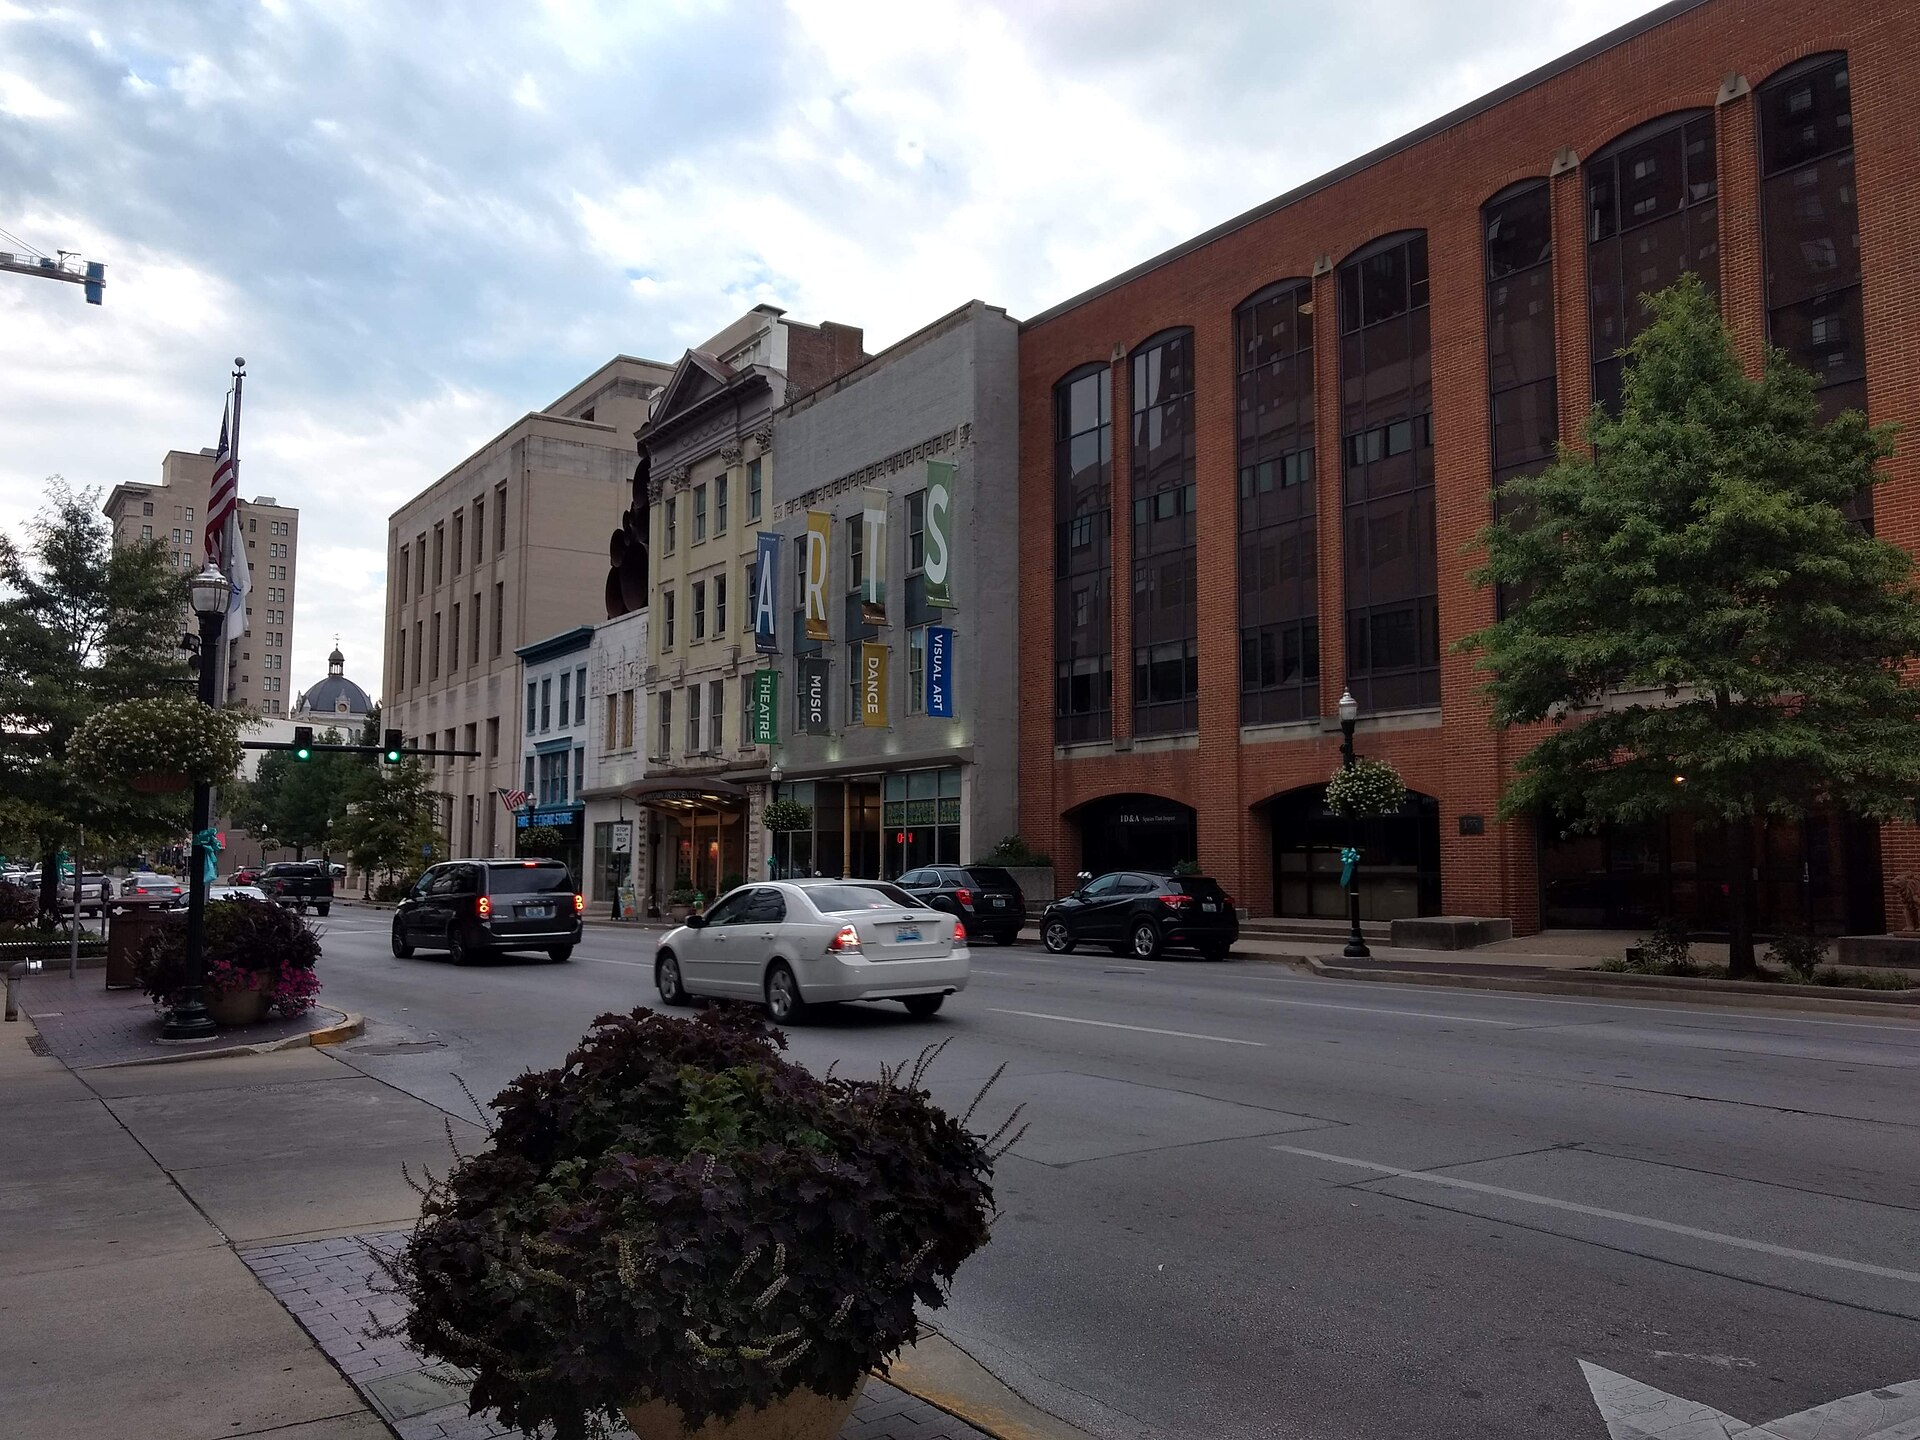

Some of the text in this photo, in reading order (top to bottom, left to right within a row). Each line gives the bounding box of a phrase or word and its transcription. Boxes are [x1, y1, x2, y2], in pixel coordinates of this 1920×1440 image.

[755, 483, 949, 635] A R T S
[810, 675, 822, 723] MUSIC
[867, 657, 879, 714] DANCE
[933, 634, 943, 711] VISUAL ART
[759, 675, 771, 739] THEATRE
[677, 790, 701, 799] CENTER
[896, 832, 913, 844] OPN
